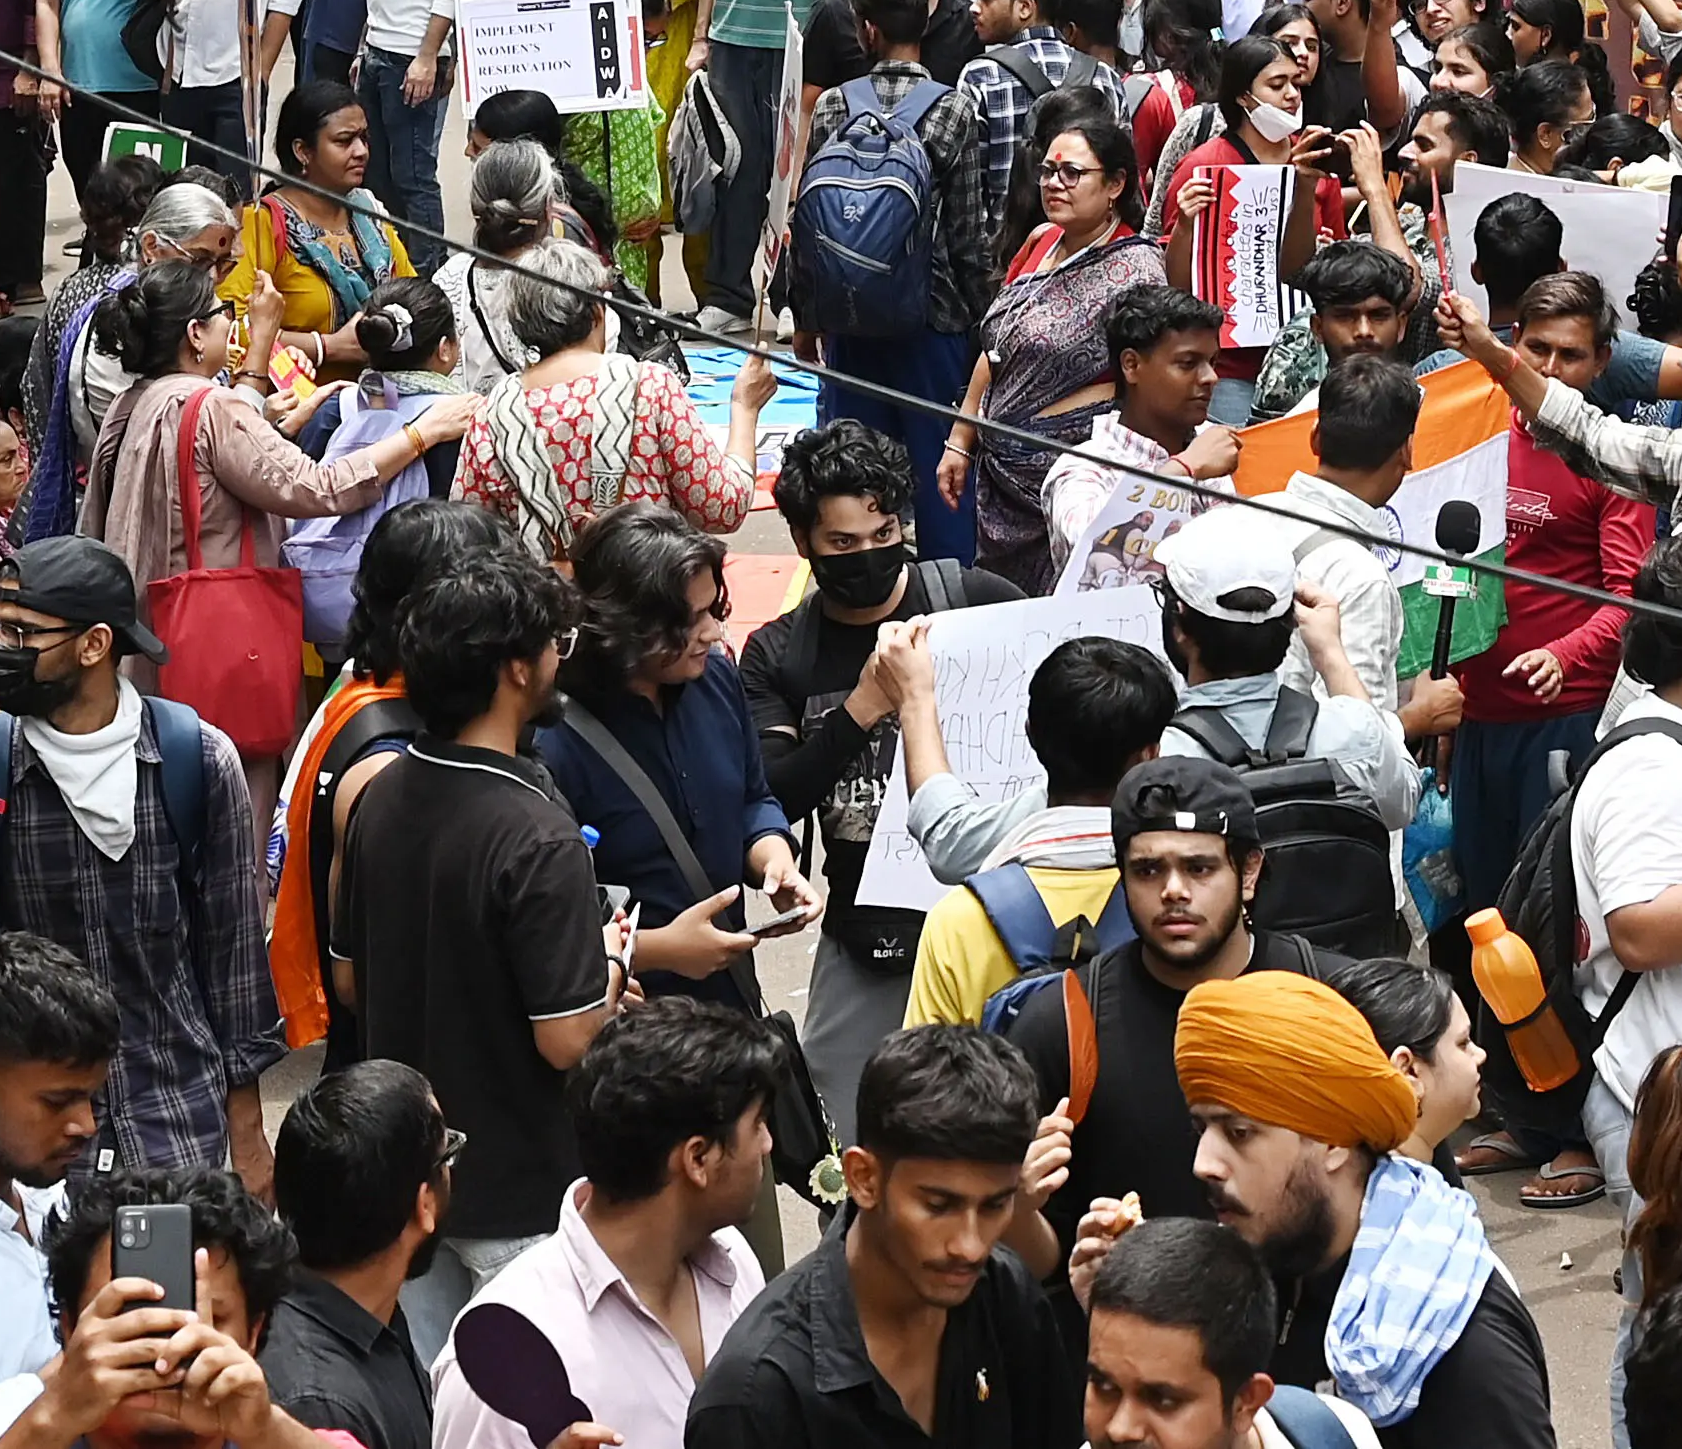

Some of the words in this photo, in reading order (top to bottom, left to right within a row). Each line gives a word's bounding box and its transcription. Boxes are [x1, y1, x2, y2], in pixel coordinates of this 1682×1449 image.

[475, 21, 555, 39] IMPLEMENT
[477, 42, 541, 57] WOMEN'S
[478, 59, 572, 77] RESERVATION
[1241, 203, 1254, 218] in
[1255, 206, 1268, 217] 3
[1238, 222, 1253, 307] characters
[1264, 239, 1277, 275] based
[1253, 223, 1268, 314] DHURANDHAR
[1267, 302, 1278, 329] can
